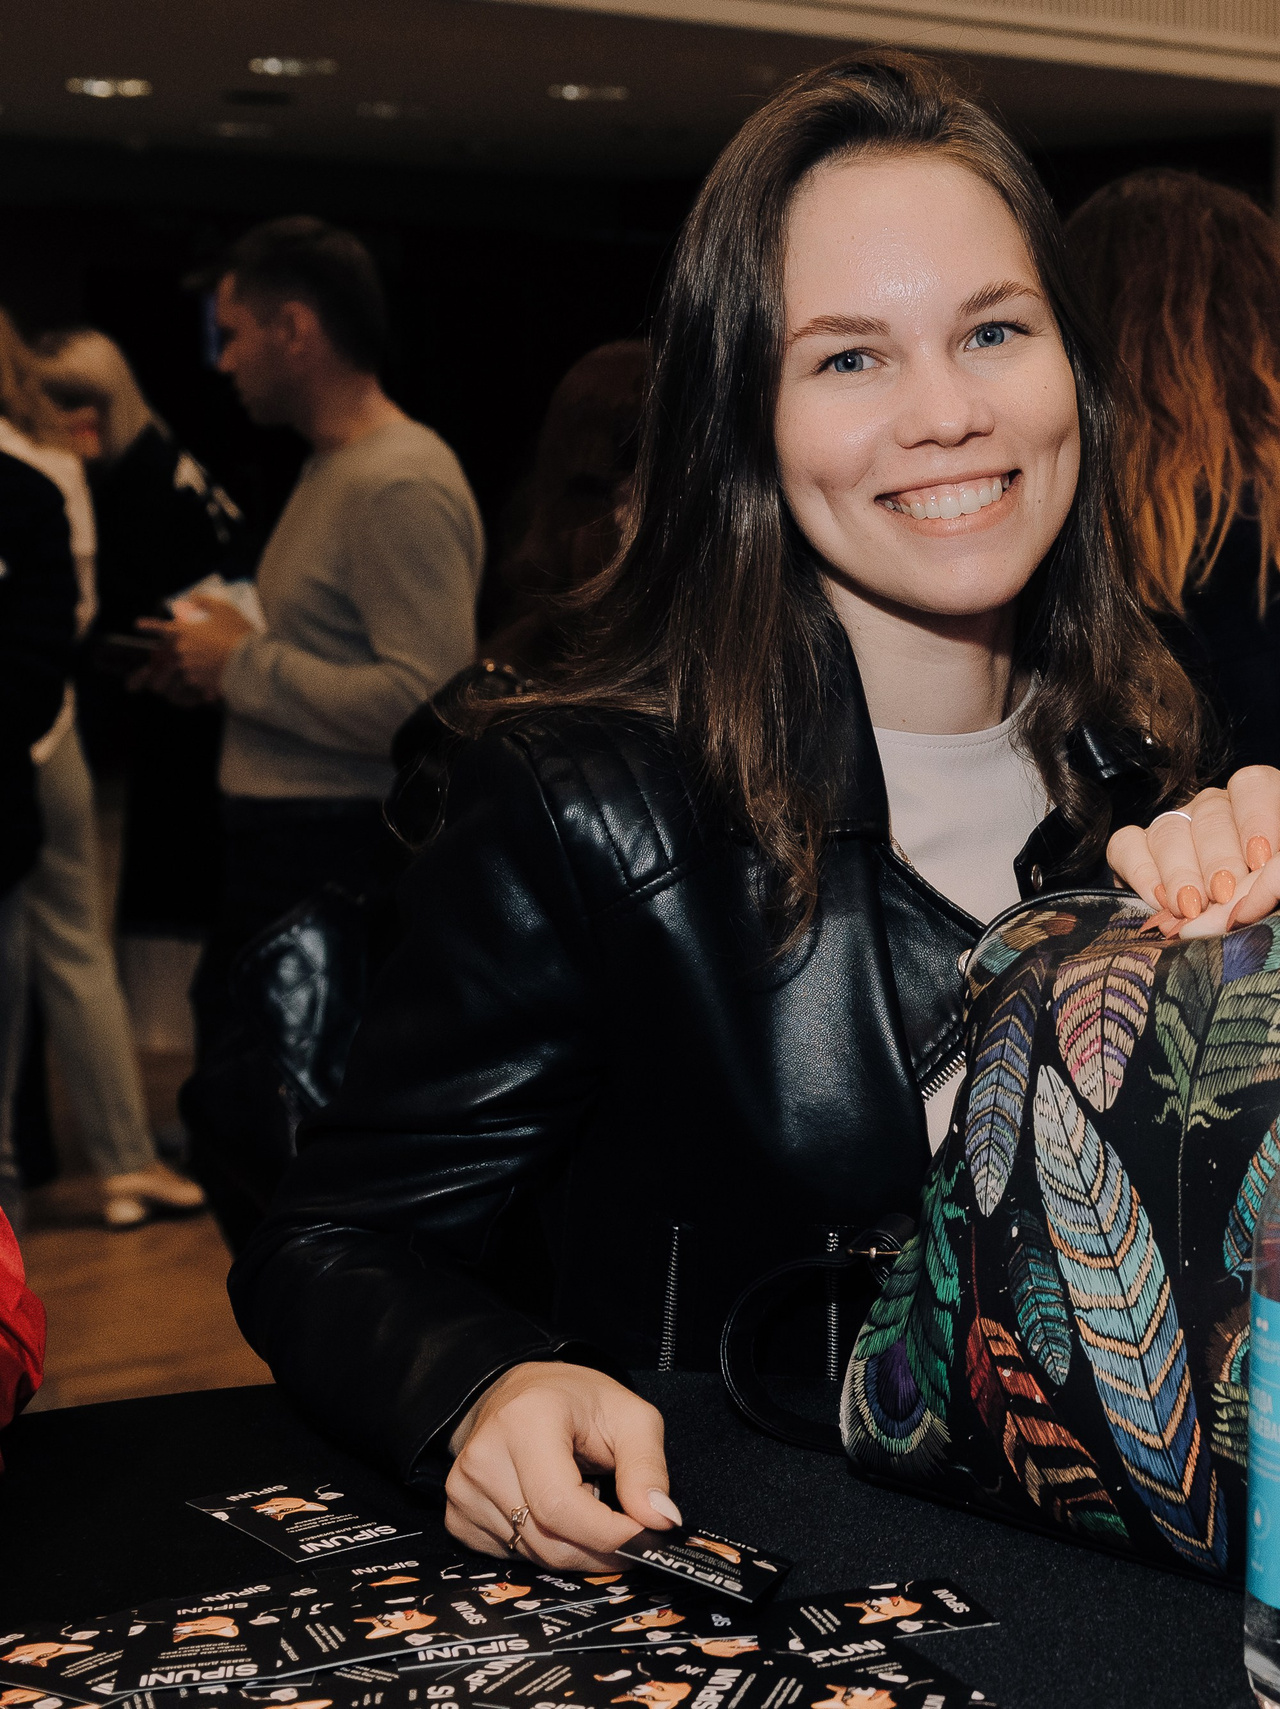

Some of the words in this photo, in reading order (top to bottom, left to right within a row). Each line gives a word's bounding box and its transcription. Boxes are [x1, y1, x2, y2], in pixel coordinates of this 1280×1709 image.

[226, 1485, 288, 1501] SIPUNI
[299, 1525, 397, 1553] SIPUNI
[351, 1560, 419, 1576] SIPUNI
[642, 1550, 743, 1592] SIPUNI
[202, 1584, 271, 1602] SIPUNI
[176, 1602, 248, 1615] SIPUNI
[418, 1639, 530, 1661] SIPUNI
[139, 1663, 258, 1687] SIPUNI
